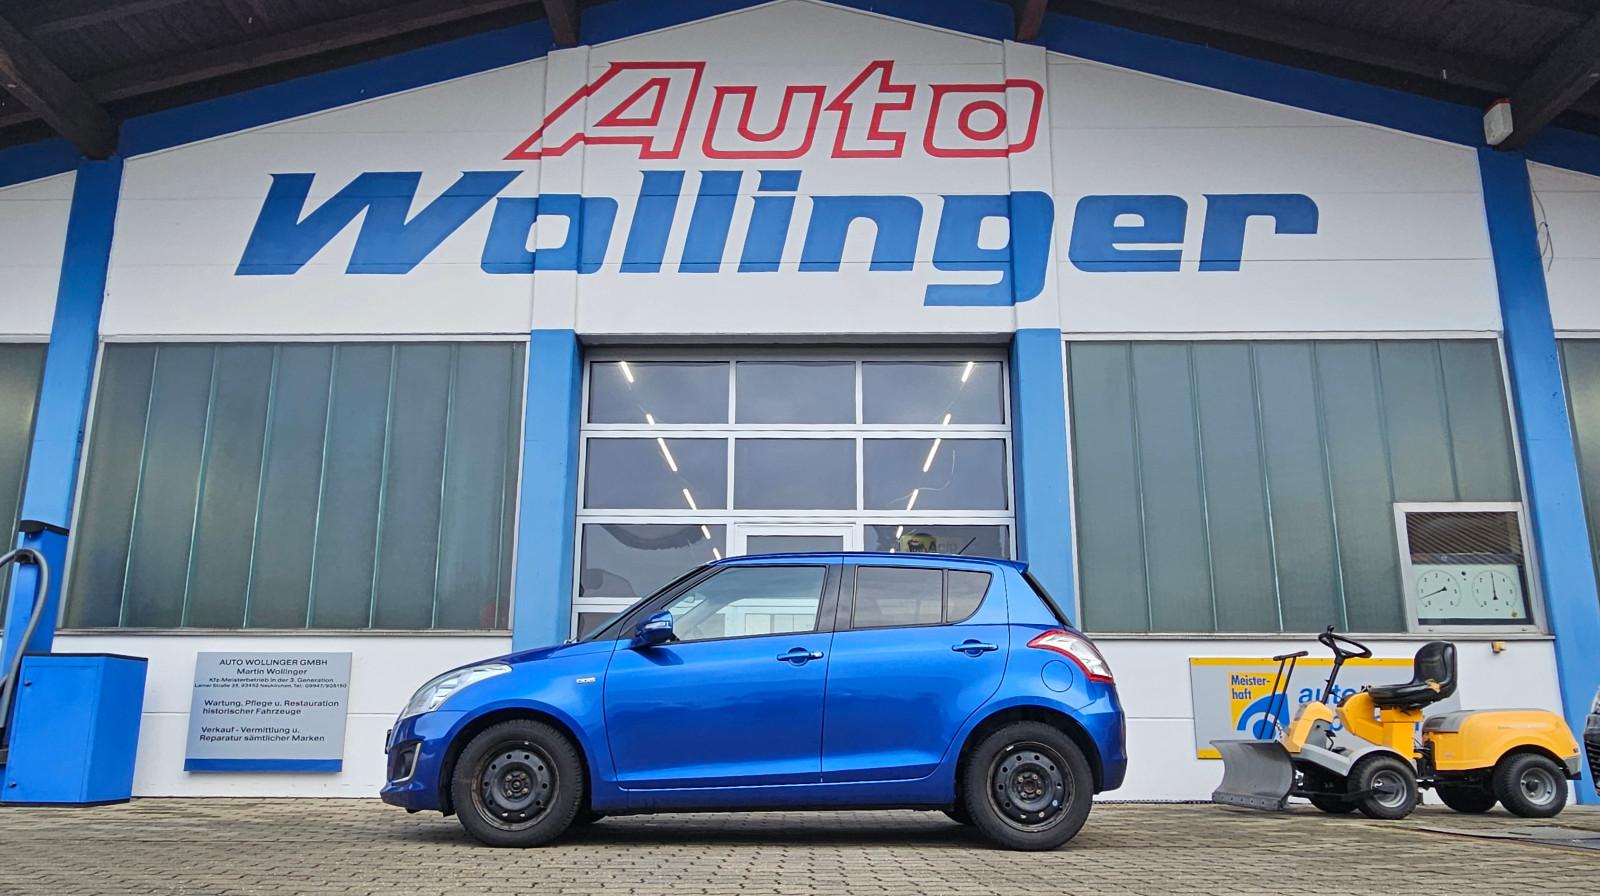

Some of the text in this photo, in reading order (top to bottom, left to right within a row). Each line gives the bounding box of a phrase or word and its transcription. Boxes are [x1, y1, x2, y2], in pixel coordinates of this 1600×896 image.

[503, 60, 1044, 160] Auto
[234, 169, 1319, 307] Wollinger
[266, 668, 307, 676] Wollinger
[1231, 675, 1271, 686] Meister-
[1232, 688, 1251, 699] haft
[256, 708, 302, 716] Fahrzeuge
